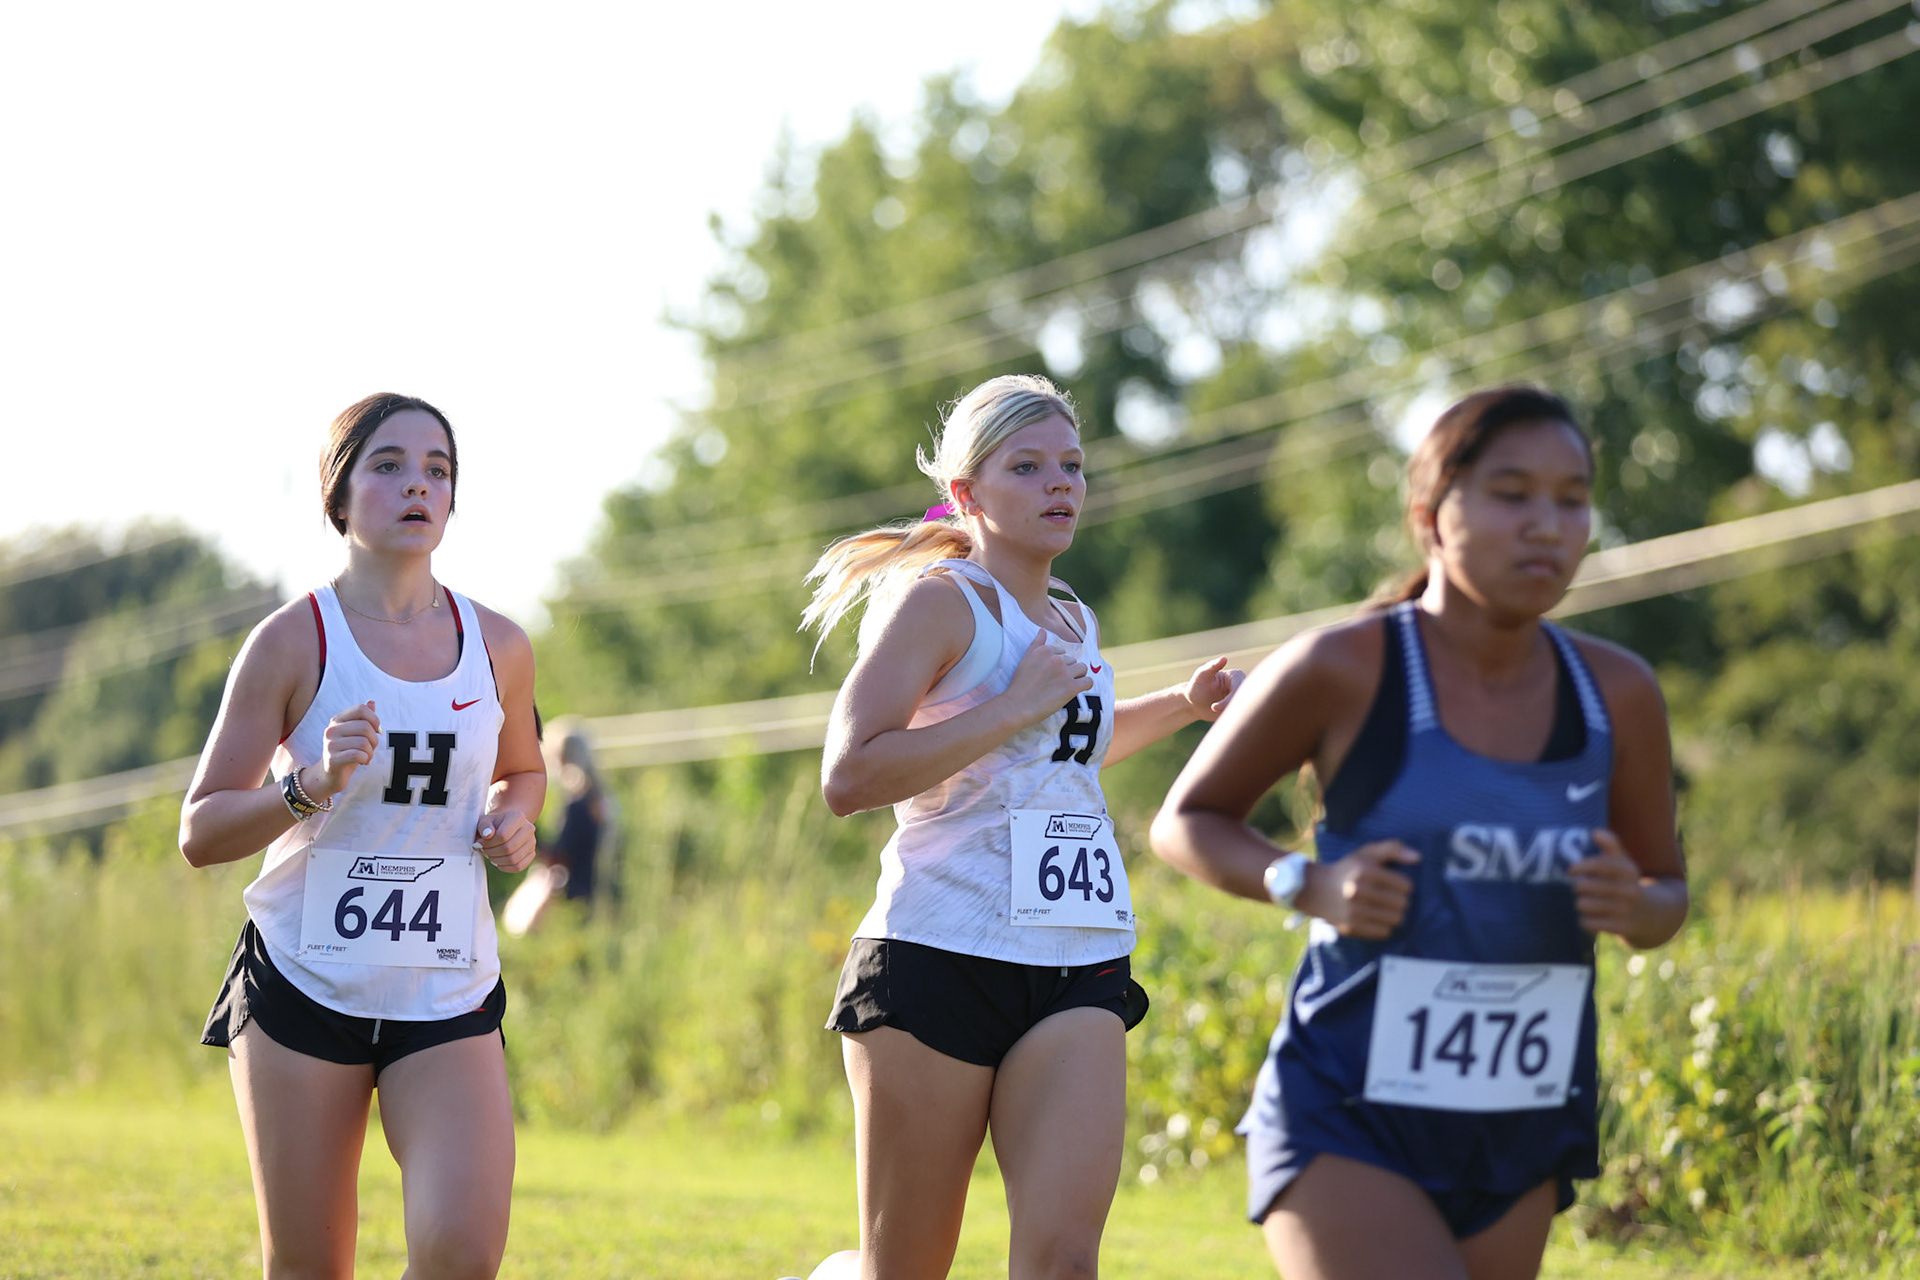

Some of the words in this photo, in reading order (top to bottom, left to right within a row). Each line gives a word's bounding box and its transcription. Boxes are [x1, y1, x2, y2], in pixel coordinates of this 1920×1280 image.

[1051, 694, 1102, 765] H
[382, 730, 457, 808] H
[1052, 820, 1065, 832] M
[357, 862, 374, 874] M
[1038, 845, 1114, 903] 643
[335, 887, 442, 942] 644
[306, 943, 326, 951] FLEET
[1406, 1004, 1550, 1078] 1476
